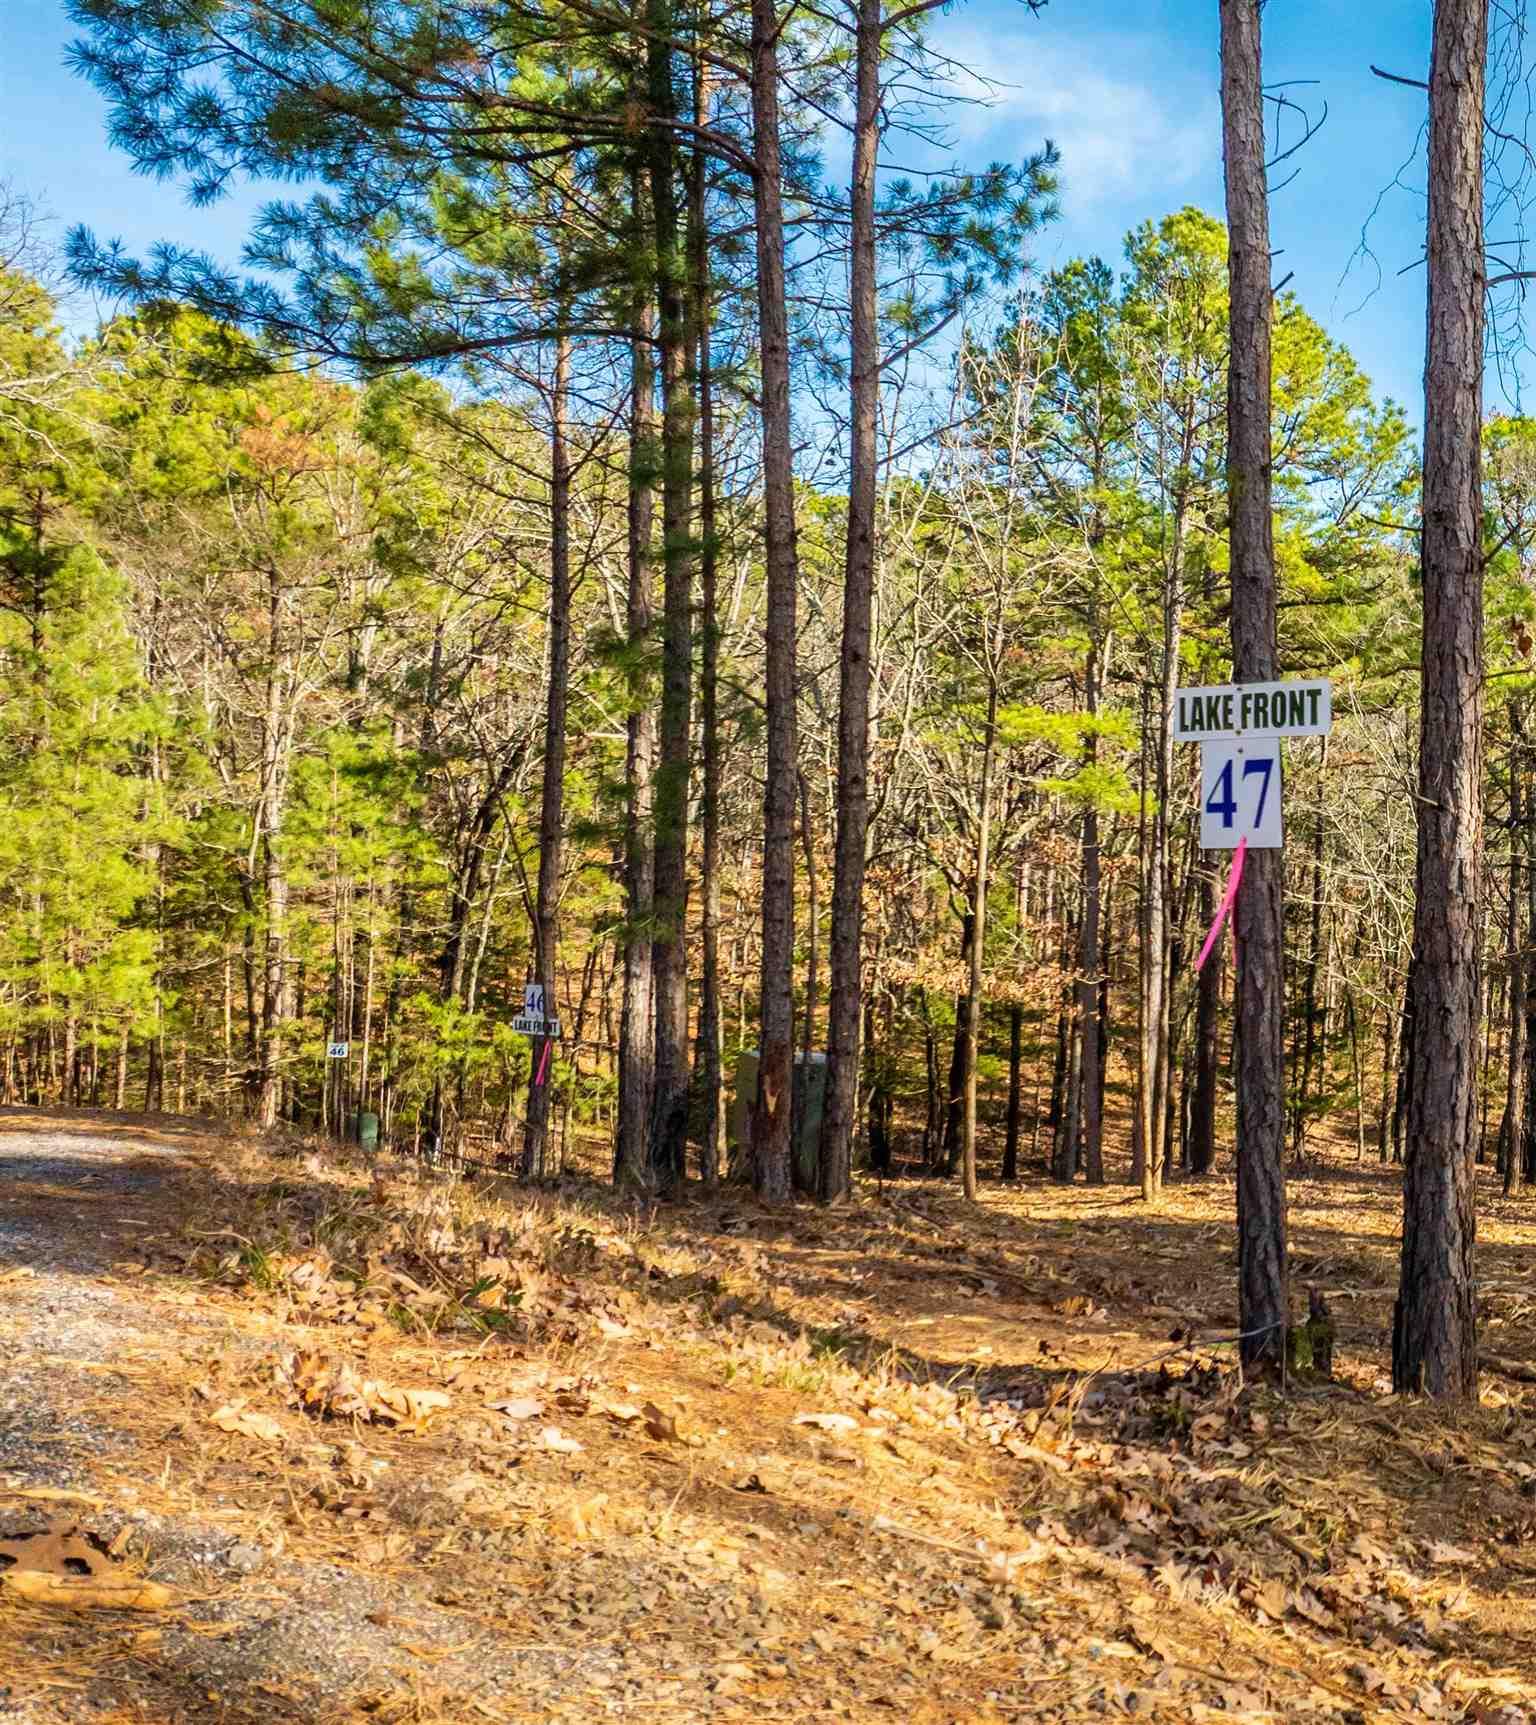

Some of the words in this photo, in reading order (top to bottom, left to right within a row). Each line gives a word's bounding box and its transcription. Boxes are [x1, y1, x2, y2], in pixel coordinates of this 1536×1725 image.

[1179, 695, 1234, 732] LAKE
[1240, 688, 1322, 729] FRONT
[1205, 758, 1274, 829] 47
[514, 1019, 532, 1032] LAKE
